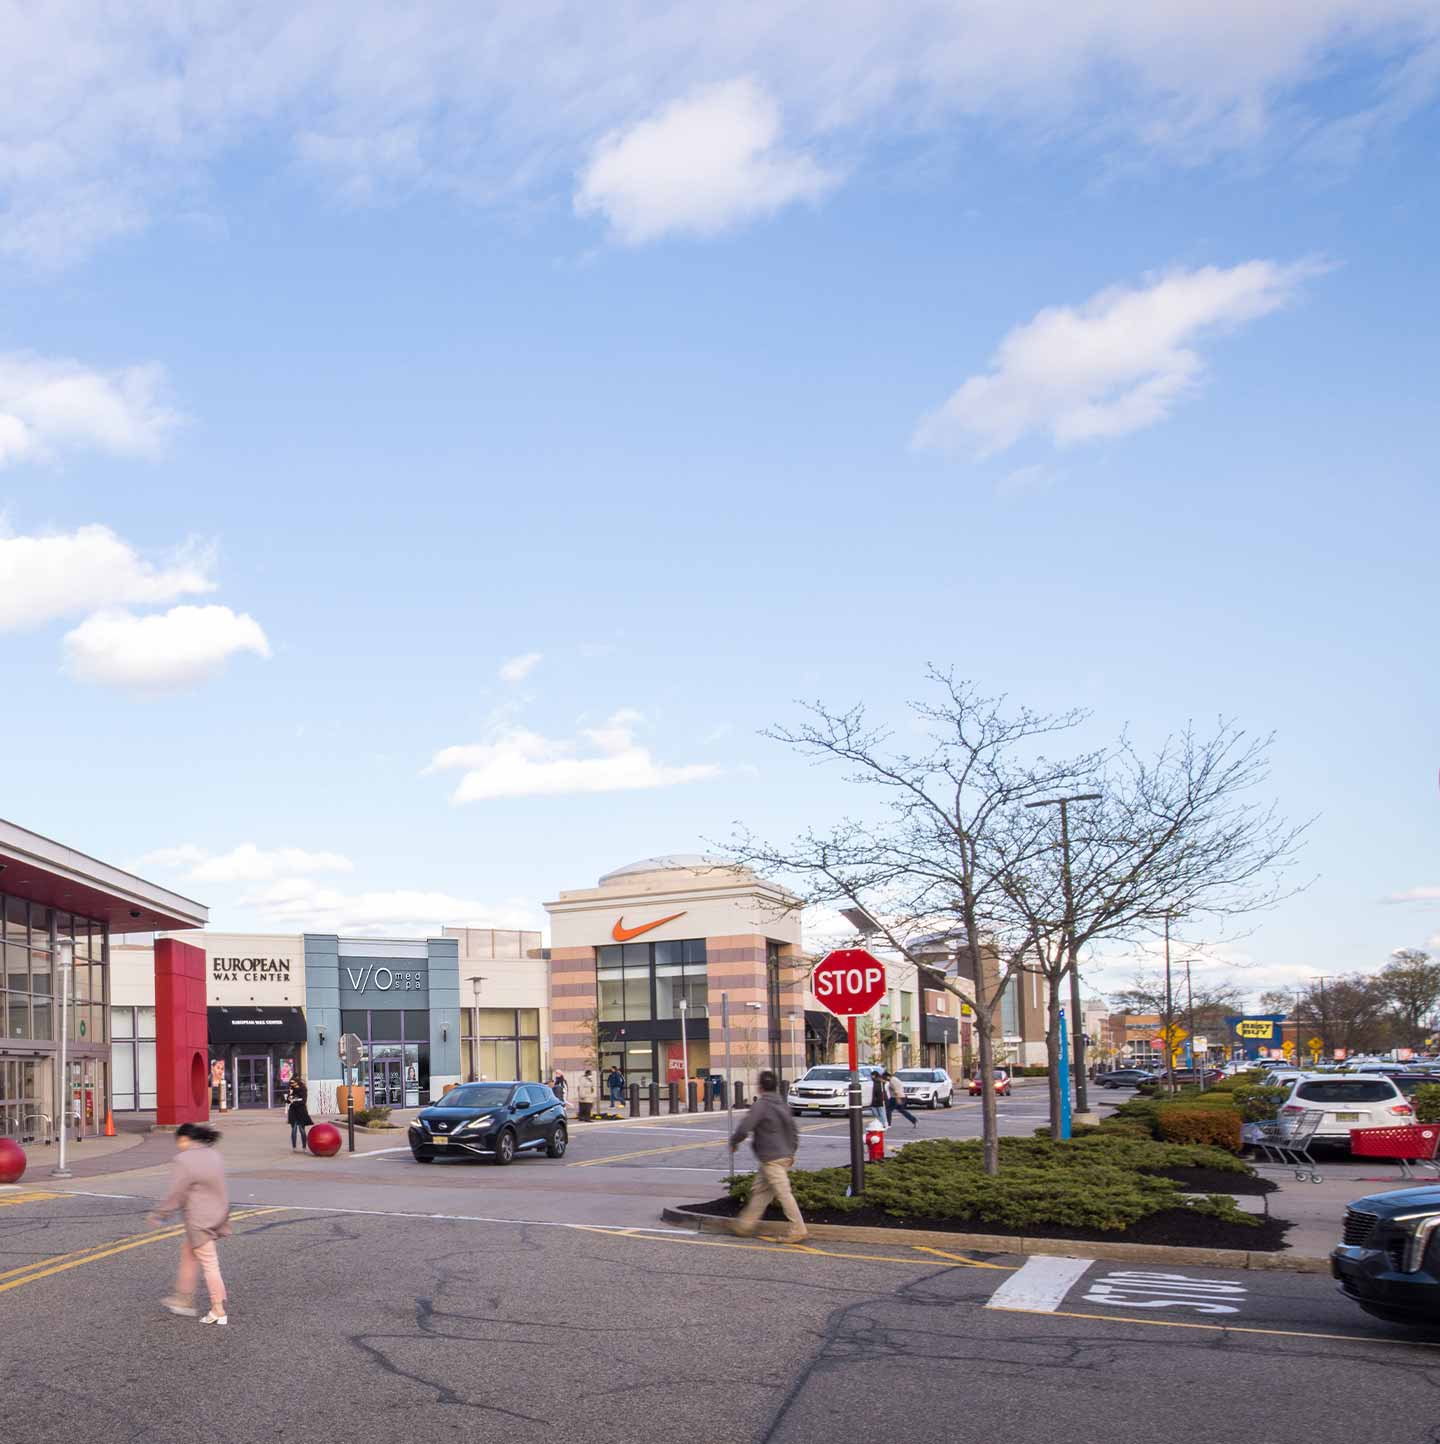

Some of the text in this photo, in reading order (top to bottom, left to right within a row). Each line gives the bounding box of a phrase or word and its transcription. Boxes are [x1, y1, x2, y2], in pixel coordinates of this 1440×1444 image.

[213, 957, 290, 972] EUROPEAN
[214, 973, 290, 982] WAX CENTER
[395, 971, 421, 981] med
[818, 968, 881, 996] STOP
[395, 981, 421, 990] spa
[1082, 1271, 1249, 1313] STOP
